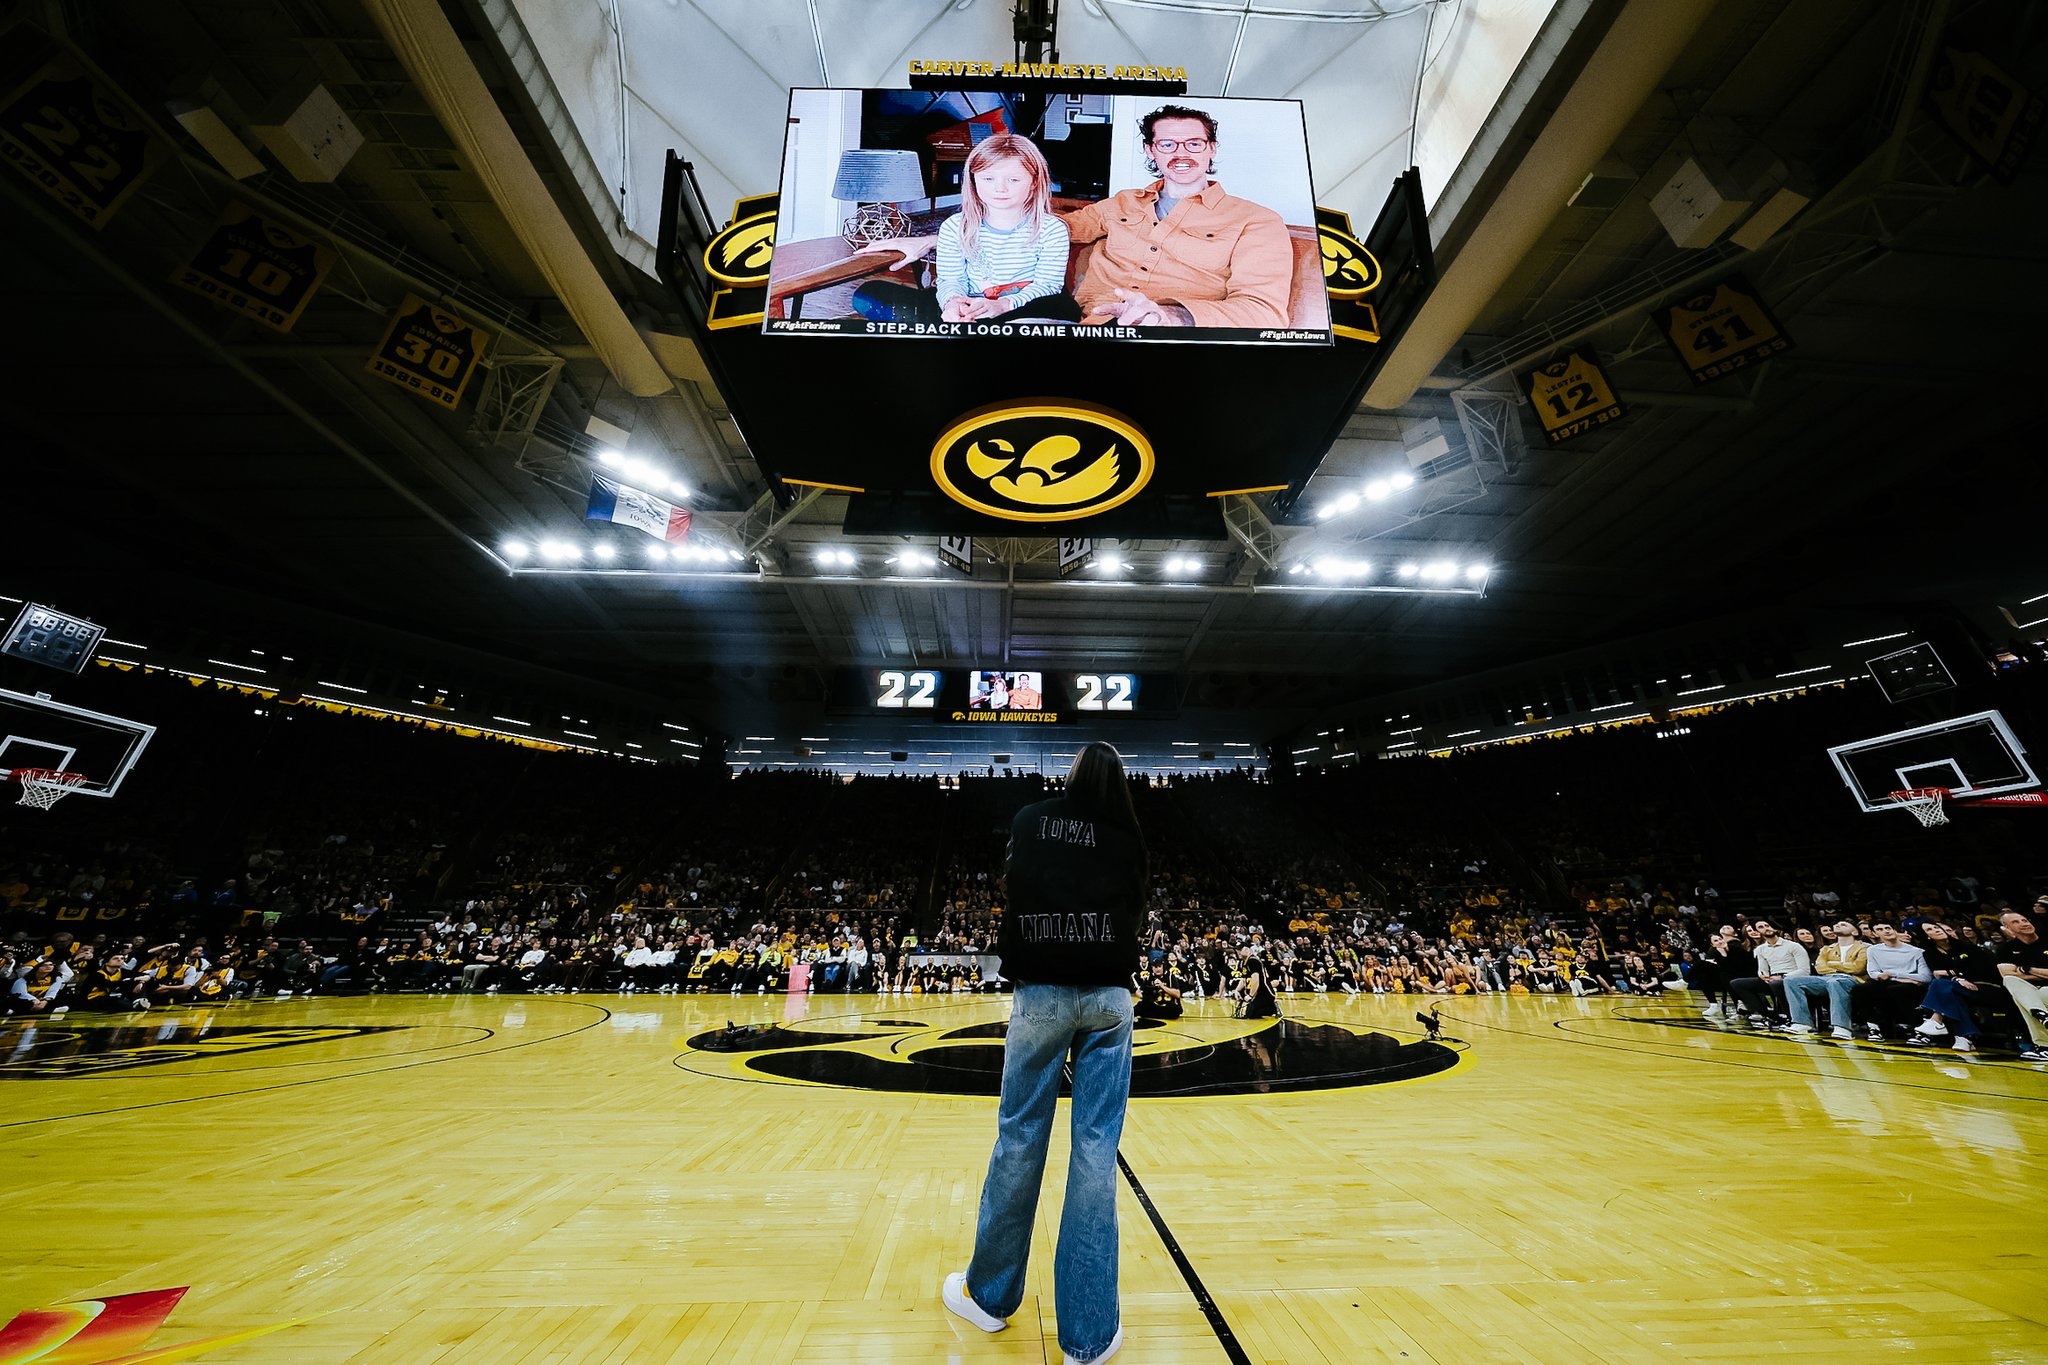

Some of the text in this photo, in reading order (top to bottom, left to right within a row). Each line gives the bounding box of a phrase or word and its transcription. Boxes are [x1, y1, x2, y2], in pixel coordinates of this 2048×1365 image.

[909, 60, 1187, 82] CARVER-HAWKEYE ARENA
[21, 105, 122, 192] 22
[219, 249, 293, 297] 10
[866, 321, 1143, 339] STEP-BACK LOGO GAME WINNER.
[1694, 315, 1754, 353] 41
[395, 332, 461, 380] 30
[1546, 373, 1583, 394] LESTER
[1547, 382, 1599, 418] 12
[1551, 406, 1622, 442] 1977-80
[877, 671, 936, 708] 22
[1076, 674, 1133, 711] 22
[967, 712, 1058, 722] IOWA HAWKEYES
[1037, 816, 1096, 847] IOWA
[1018, 913, 1115, 942] INDIANA
